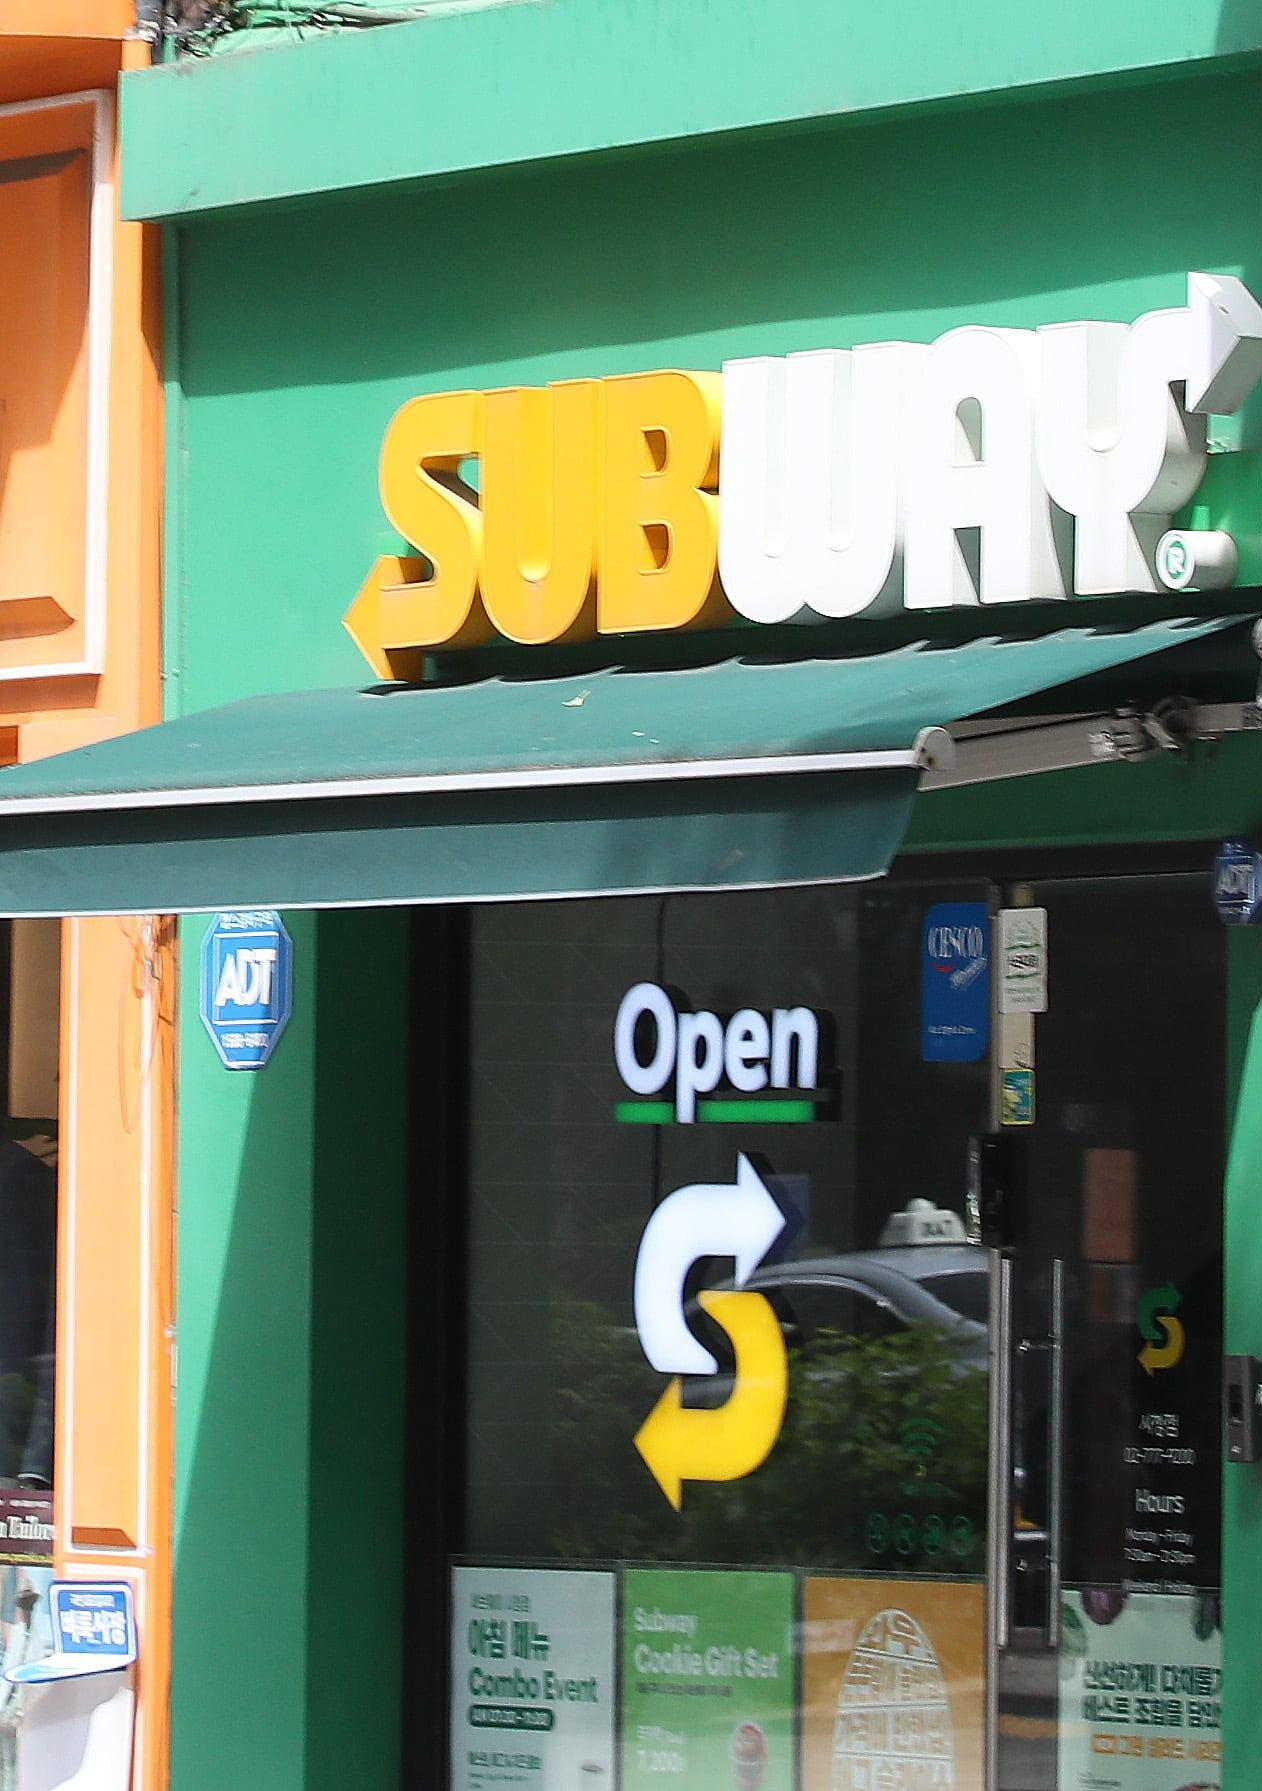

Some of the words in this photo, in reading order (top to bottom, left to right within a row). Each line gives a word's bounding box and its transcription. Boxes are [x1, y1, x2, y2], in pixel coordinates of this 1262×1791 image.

[214, 947, 279, 1007] ADT
[614, 981, 818, 1124] Open
[1135, 1489, 1185, 1514] Hours
[634, 1607, 698, 1638] Subway
[634, 1643, 703, 1675] Cookie
[704, 1646, 743, 1677] Gift
[744, 1647, 780, 1679] Set
[469, 1666, 539, 1699] Combo
[544, 1669, 598, 1702] Event
